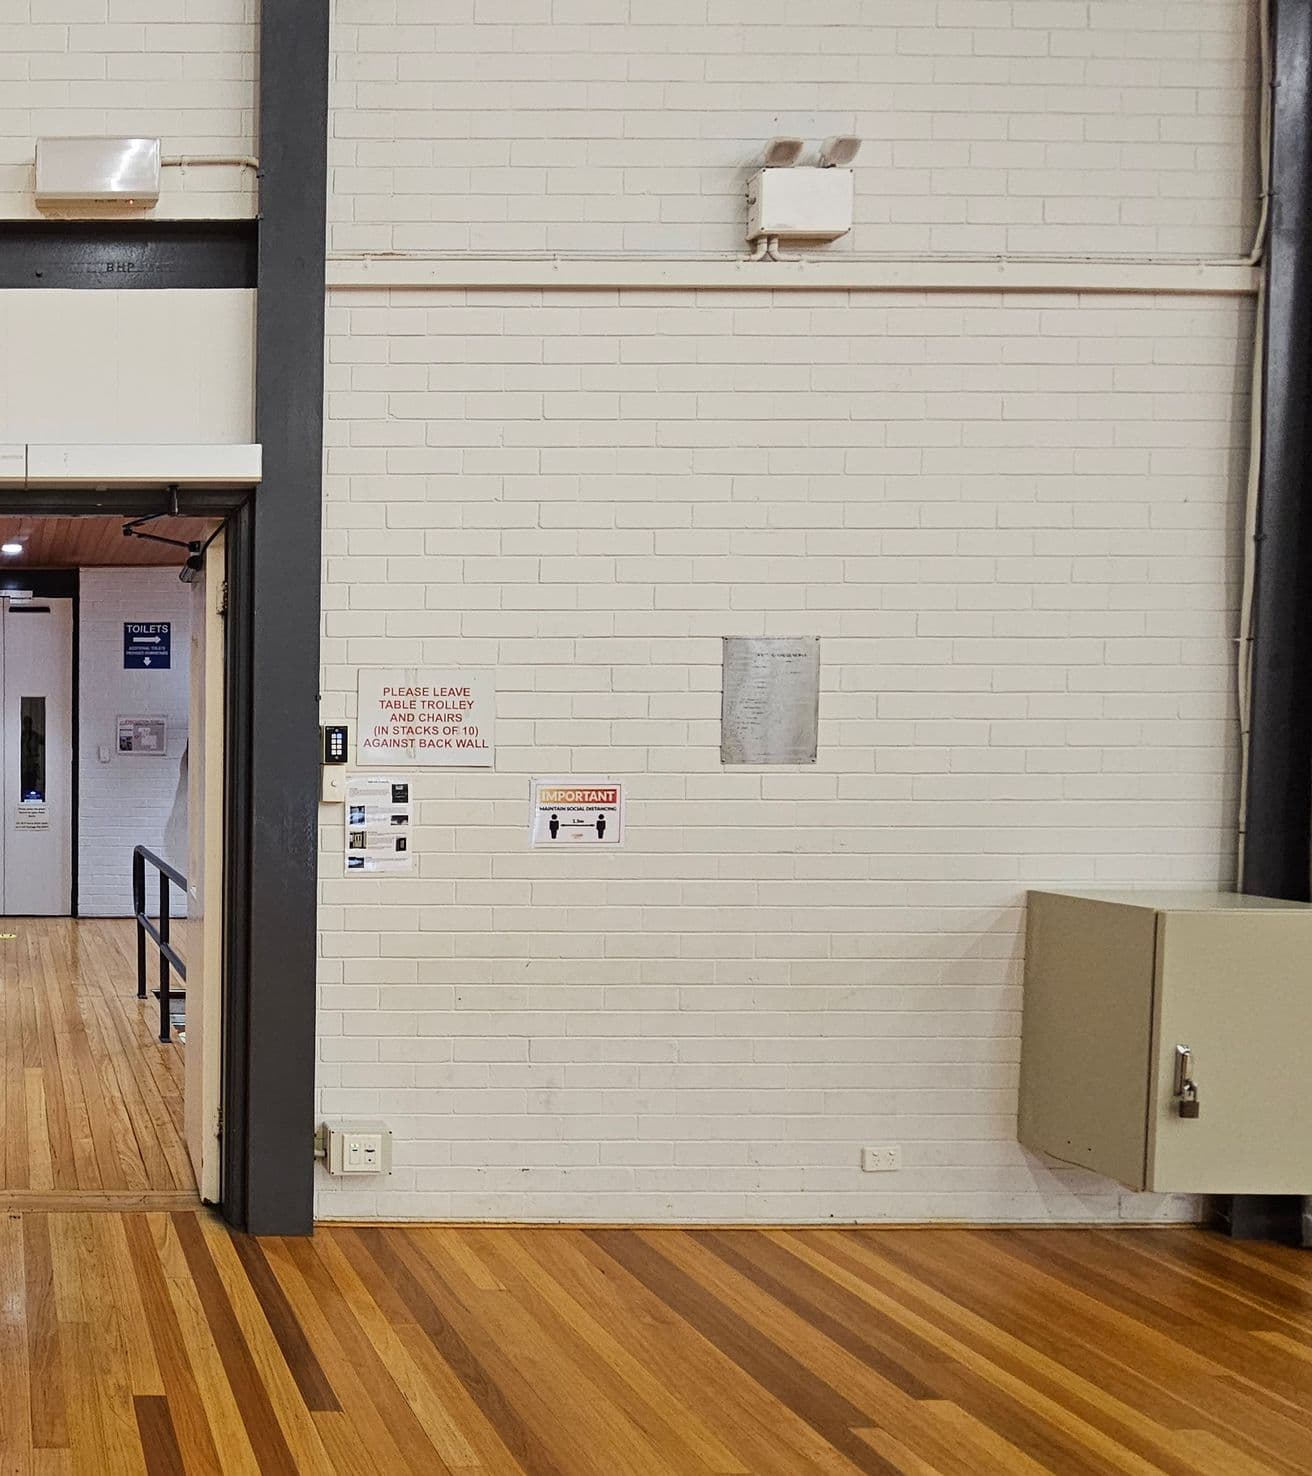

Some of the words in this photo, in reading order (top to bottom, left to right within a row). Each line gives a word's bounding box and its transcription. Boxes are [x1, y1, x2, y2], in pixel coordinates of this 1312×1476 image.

[106, 262, 135, 273] BHP
[126, 624, 169, 633] TOILETS
[383, 687, 430, 697] PLEASE
[433, 687, 471, 697] LEAVE
[379, 700, 417, 709] TABLE
[420, 700, 475, 709] TROLLEY
[390, 713, 415, 722] AND
[418, 713, 463, 722] CHAIRS
[374, 726, 388, 737] (IN
[392, 726, 439, 736] STACKS
[442, 726, 458, 735] OF
[463, 726, 479, 737] 10)
[363, 738, 416, 748] AGAINST
[419, 738, 453, 748] BACK
[456, 738, 489, 748] WALL
[541, 790, 615, 802] IMPORTANT
